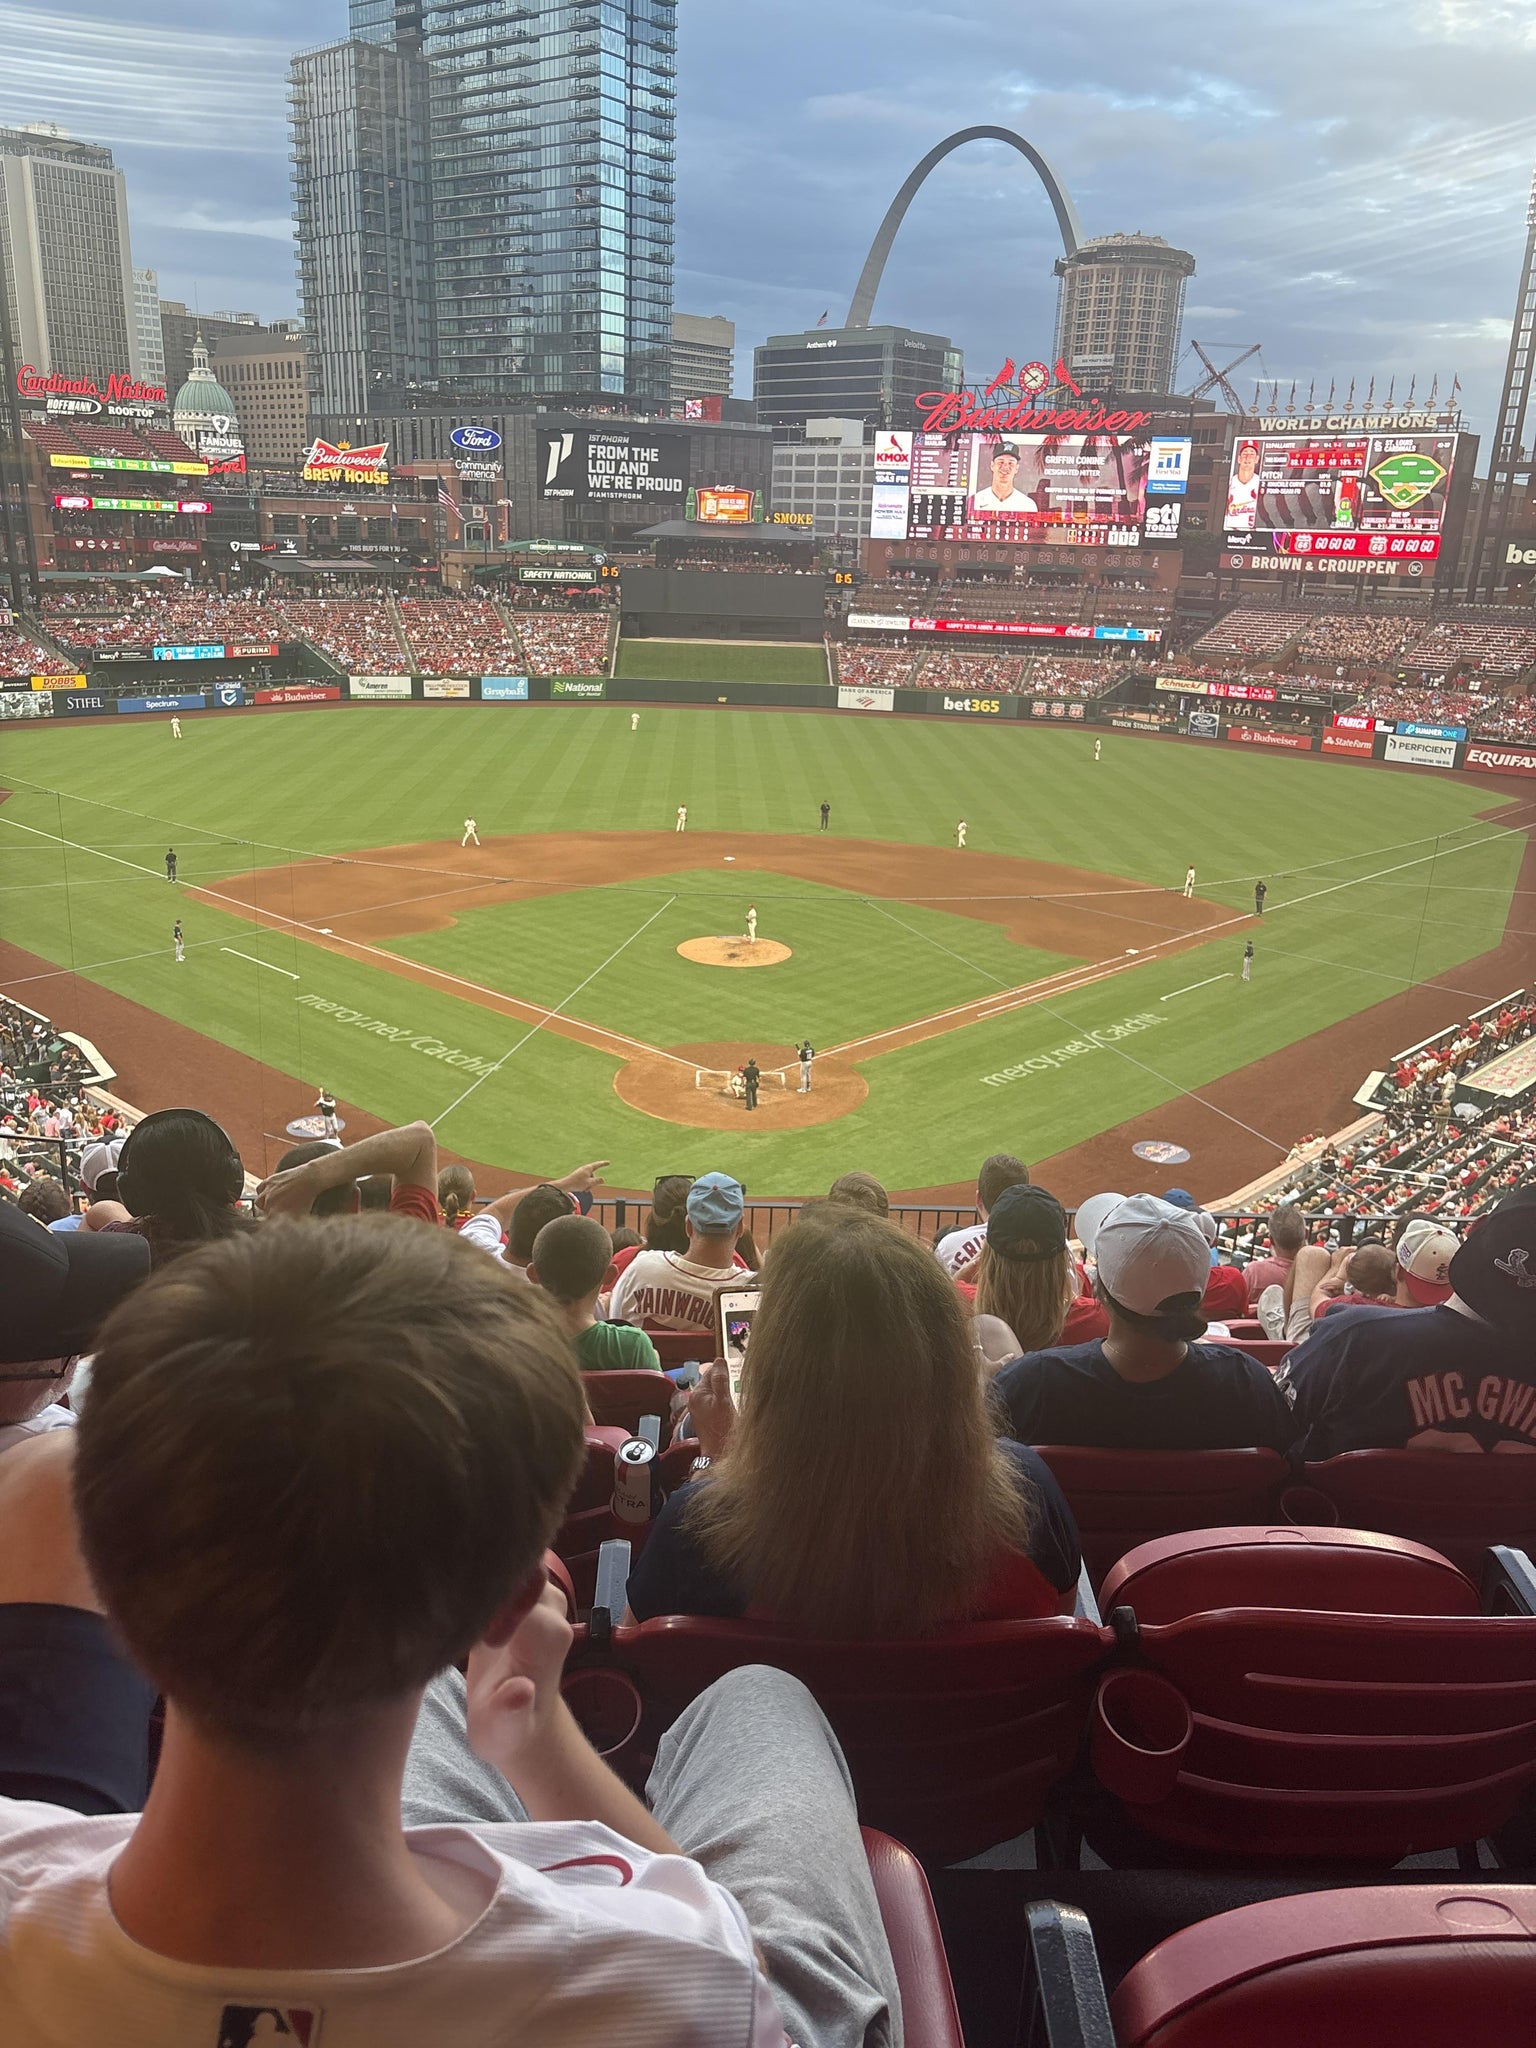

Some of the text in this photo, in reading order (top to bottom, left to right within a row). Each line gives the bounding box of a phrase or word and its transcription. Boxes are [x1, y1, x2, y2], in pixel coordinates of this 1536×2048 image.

[17, 364, 165, 402] Cardinals Nation
[46, 398, 93, 412] HOFFMANN
[108, 406, 155, 417] ROOFTOP
[914, 391, 1152, 432] Budweiser
[1260, 415, 1438, 432] WORLD CHAMPIONS
[200, 437, 245, 448] FANDUEL
[462, 429, 492, 447] Ford
[302, 447, 387, 467] Budweiser
[588, 445, 659, 462] FROM THE
[876, 453, 909, 462] KMOX
[455, 460, 502, 473] Community
[1045, 456, 1106, 466] GRIFFIN CONINE
[588, 460, 649, 476] LOU AND
[304, 466, 390, 485] BREW HOUSE
[588, 474, 683, 492] WE'RE PROUD
[588, 491, 643, 500] #IAM1STPHORM
[774, 513, 814, 525] SMOKE
[1146, 503, 1182, 525] stl
[1145, 524, 1179, 532] TODAY
[1228, 535, 1247, 546] Mercy
[1297, 537, 1435, 553] 66 GO GO GO 66 GO GO GO
[905, 546, 910, 559] 1
[916, 547, 924, 560] 2
[929, 547, 938, 560] 6
[944, 548, 952, 561] 9
[977, 549, 989, 562] 14
[995, 550, 1008, 562] 17
[1014, 551, 1030, 564] 20
[1038, 552, 1054, 565] 23
[1059, 552, 1075, 565] 24
[1082, 554, 1098, 566] 42
[1104, 555, 1121, 567] 45
[1125, 556, 1142, 568] 85
[1251, 556, 1302, 571] BROWN
[1305, 561, 1314, 571] &
[1318, 559, 1397, 574] CROUPPEN
[523, 570, 593, 580] SAFETY NATIONAL
[100, 652, 117, 660] Mercy
[242, 647, 269, 655] PURINA
[44, 677, 76, 686] DOBBS
[216, 682, 241, 690] CarShield
[565, 683, 603, 692] National
[67, 696, 105, 710] STIFEL
[284, 692, 327, 702] Budweiser
[1282, 694, 1295, 702] Mercy
[146, 700, 174, 709] Spectrum
[944, 696, 1000, 714] bet365
[1112, 720, 1160, 732] BUSCH STADIUM
[1195, 716, 1213, 725] Ford
[1337, 716, 1369, 729] FABICK
[1254, 732, 1299, 747] Budweiser
[1399, 742, 1454, 755] PERFICIENT
[1407, 1372, 1472, 1427] MC
